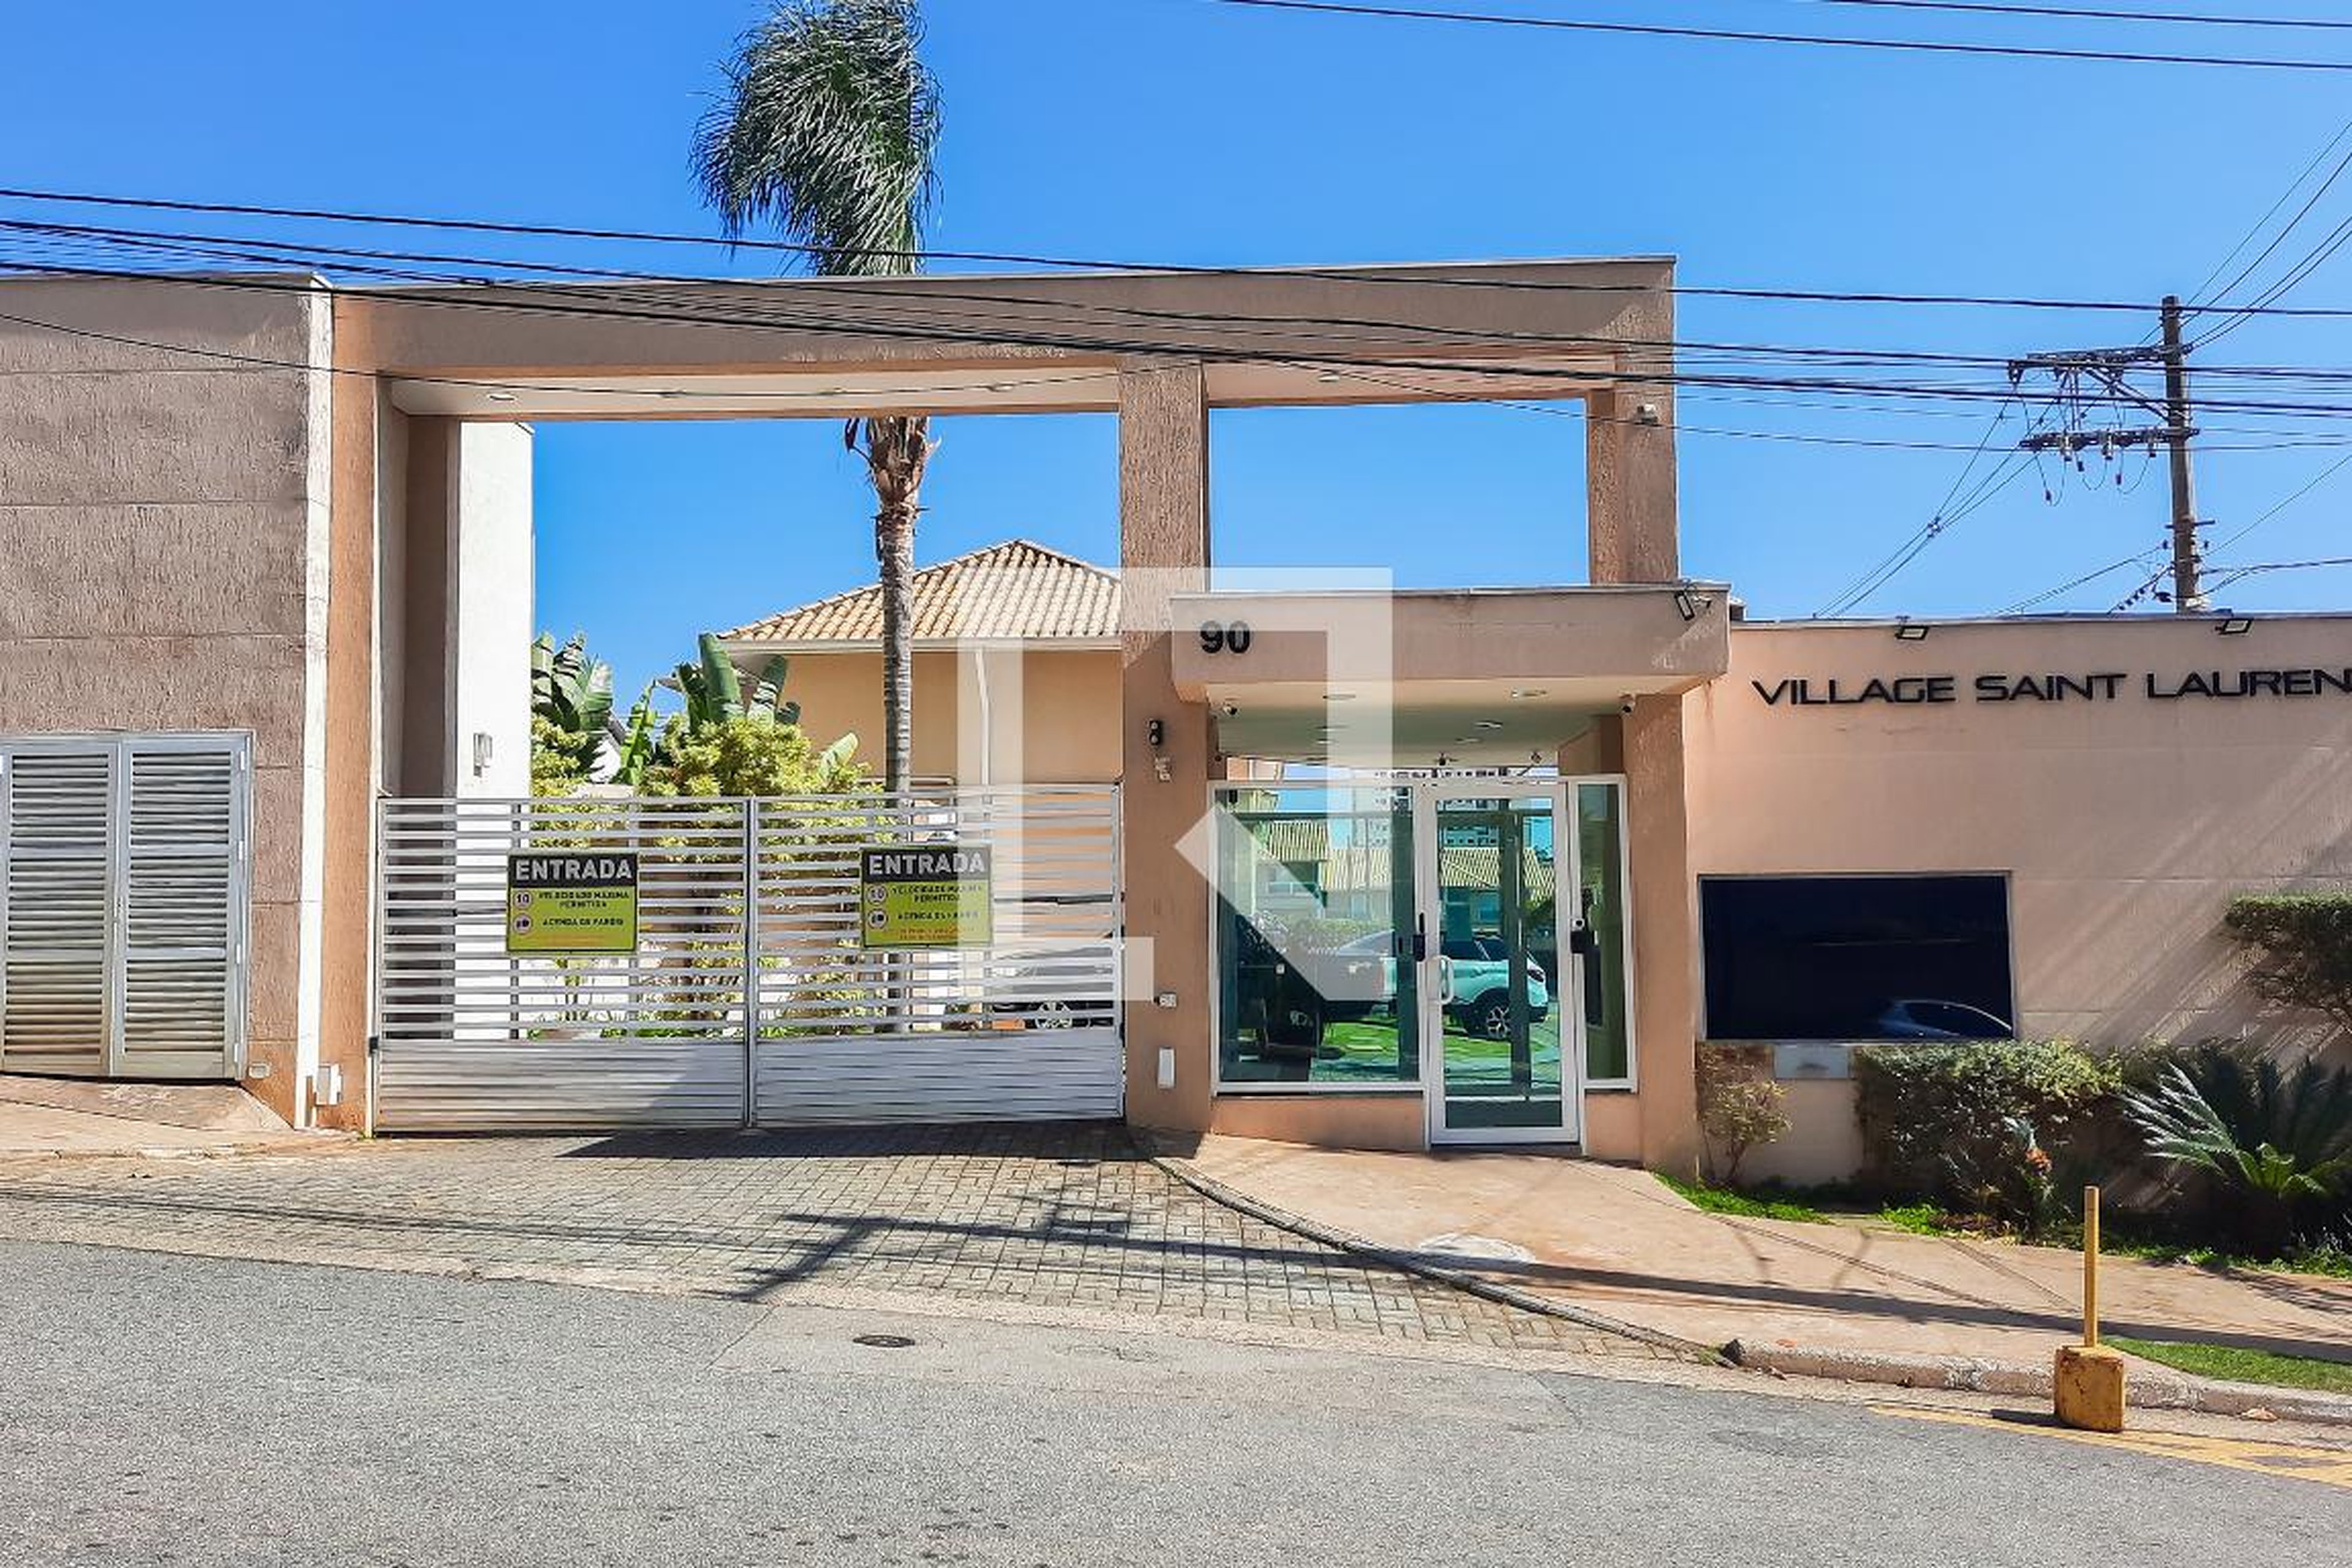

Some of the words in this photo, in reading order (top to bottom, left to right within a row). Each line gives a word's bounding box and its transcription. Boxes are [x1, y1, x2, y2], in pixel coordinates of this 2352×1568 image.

[1200, 620, 1250, 654] 90
[1752, 677, 1956, 705] VILLAGE
[1975, 674, 2127, 701] SAINT
[2147, 669, 2352, 699] LAUREN
[516, 859, 632, 880] ENTRADA
[869, 853, 986, 875] ENTRADA
